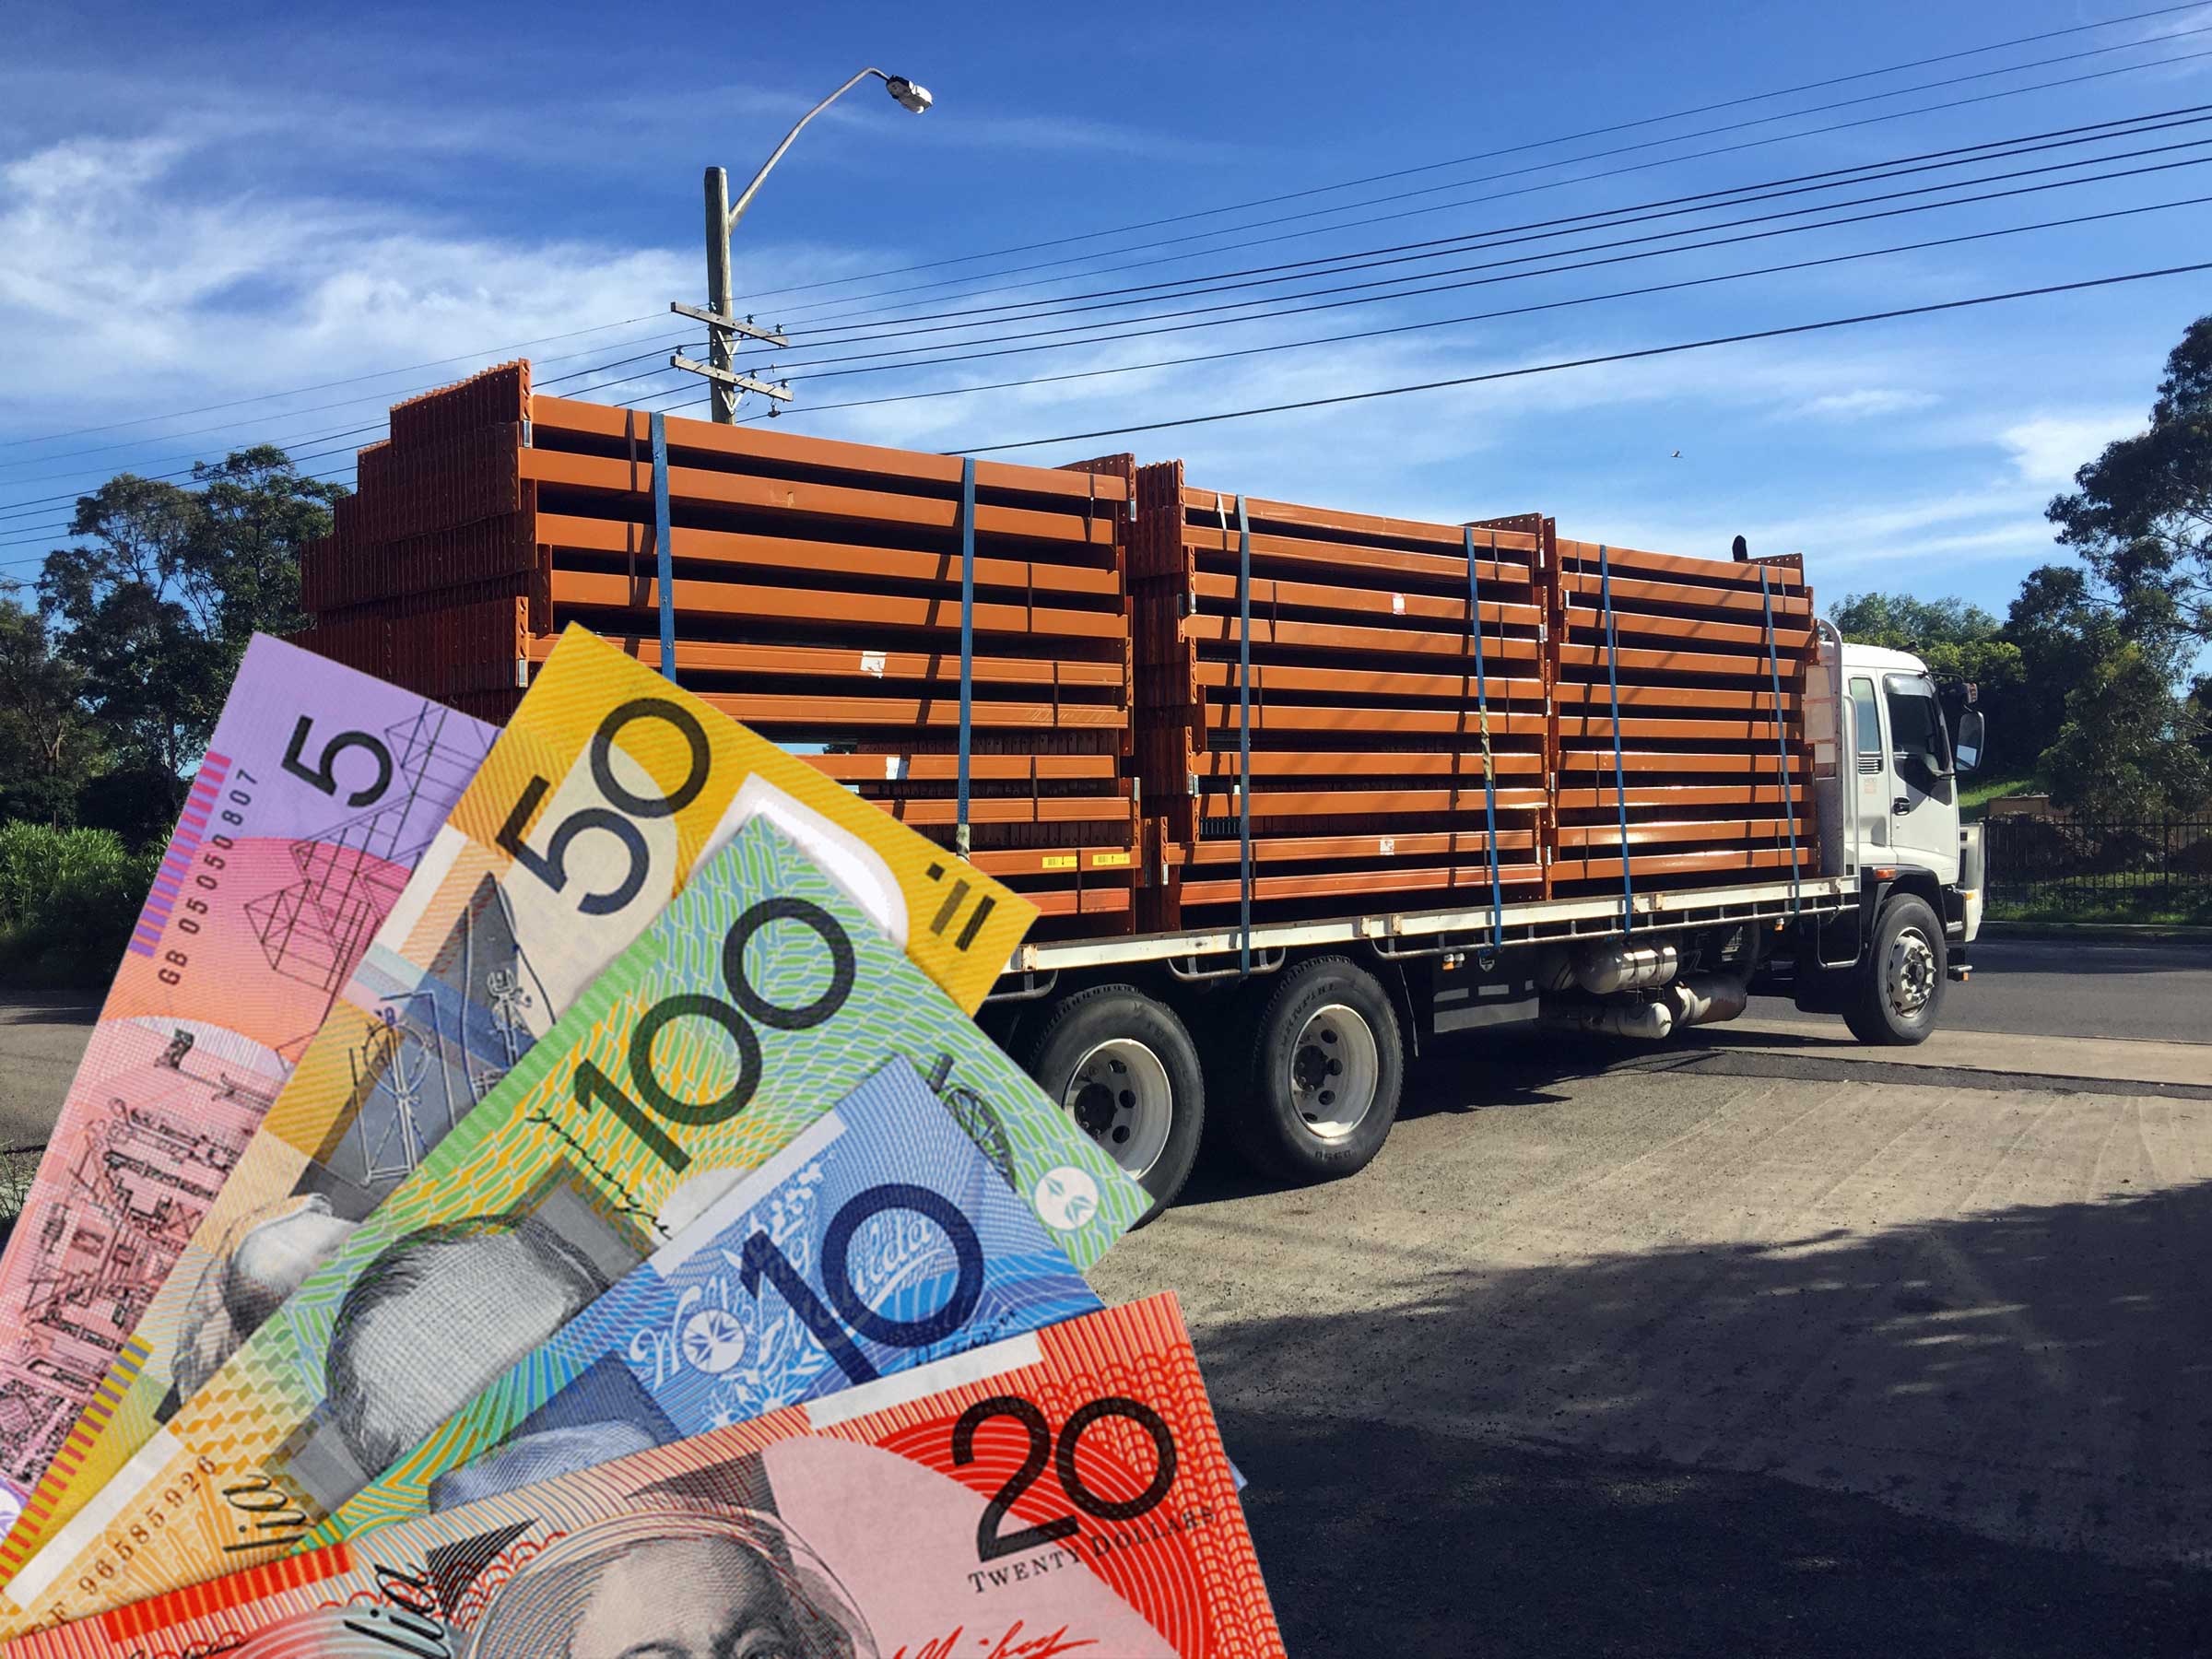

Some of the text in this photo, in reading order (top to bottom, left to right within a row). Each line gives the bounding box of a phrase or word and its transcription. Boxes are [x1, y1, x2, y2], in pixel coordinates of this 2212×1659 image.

[281, 714, 394, 808] 5
[496, 697, 712, 916] 50
[158, 769, 258, 985] GB 05050807
[573, 897, 856, 1175] 100
[739, 1183, 985, 1385] 10
[78, 1455, 216, 1595] 96585926
[952, 1394, 1178, 1562] 20
[968, 1504, 1215, 1593] TWENTY DOLLARS
